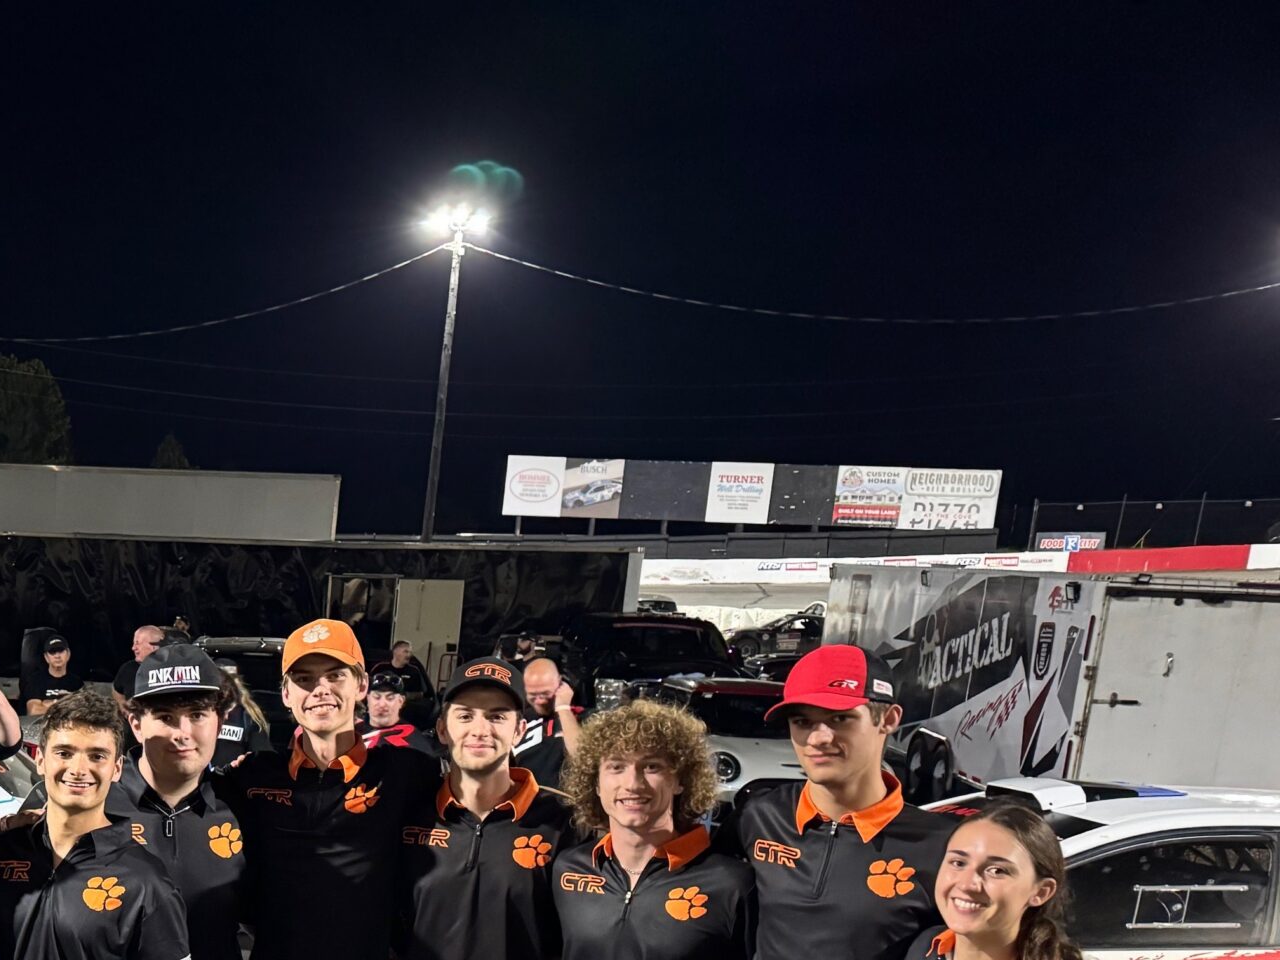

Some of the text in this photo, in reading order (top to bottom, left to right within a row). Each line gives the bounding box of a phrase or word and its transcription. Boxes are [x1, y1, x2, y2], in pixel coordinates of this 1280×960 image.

[581, 465, 608, 474] BUSCH
[719, 474, 764, 484] TURNER
[910, 472, 995, 492] NEIGHBORHOOD
[1040, 538, 1065, 549] FOOD
[1079, 538, 1100, 549] CITY
[464, 662, 512, 685] CTR
[402, 826, 451, 848] CTR
[754, 838, 801, 868] CTR
[560, 871, 605, 895] CTR
